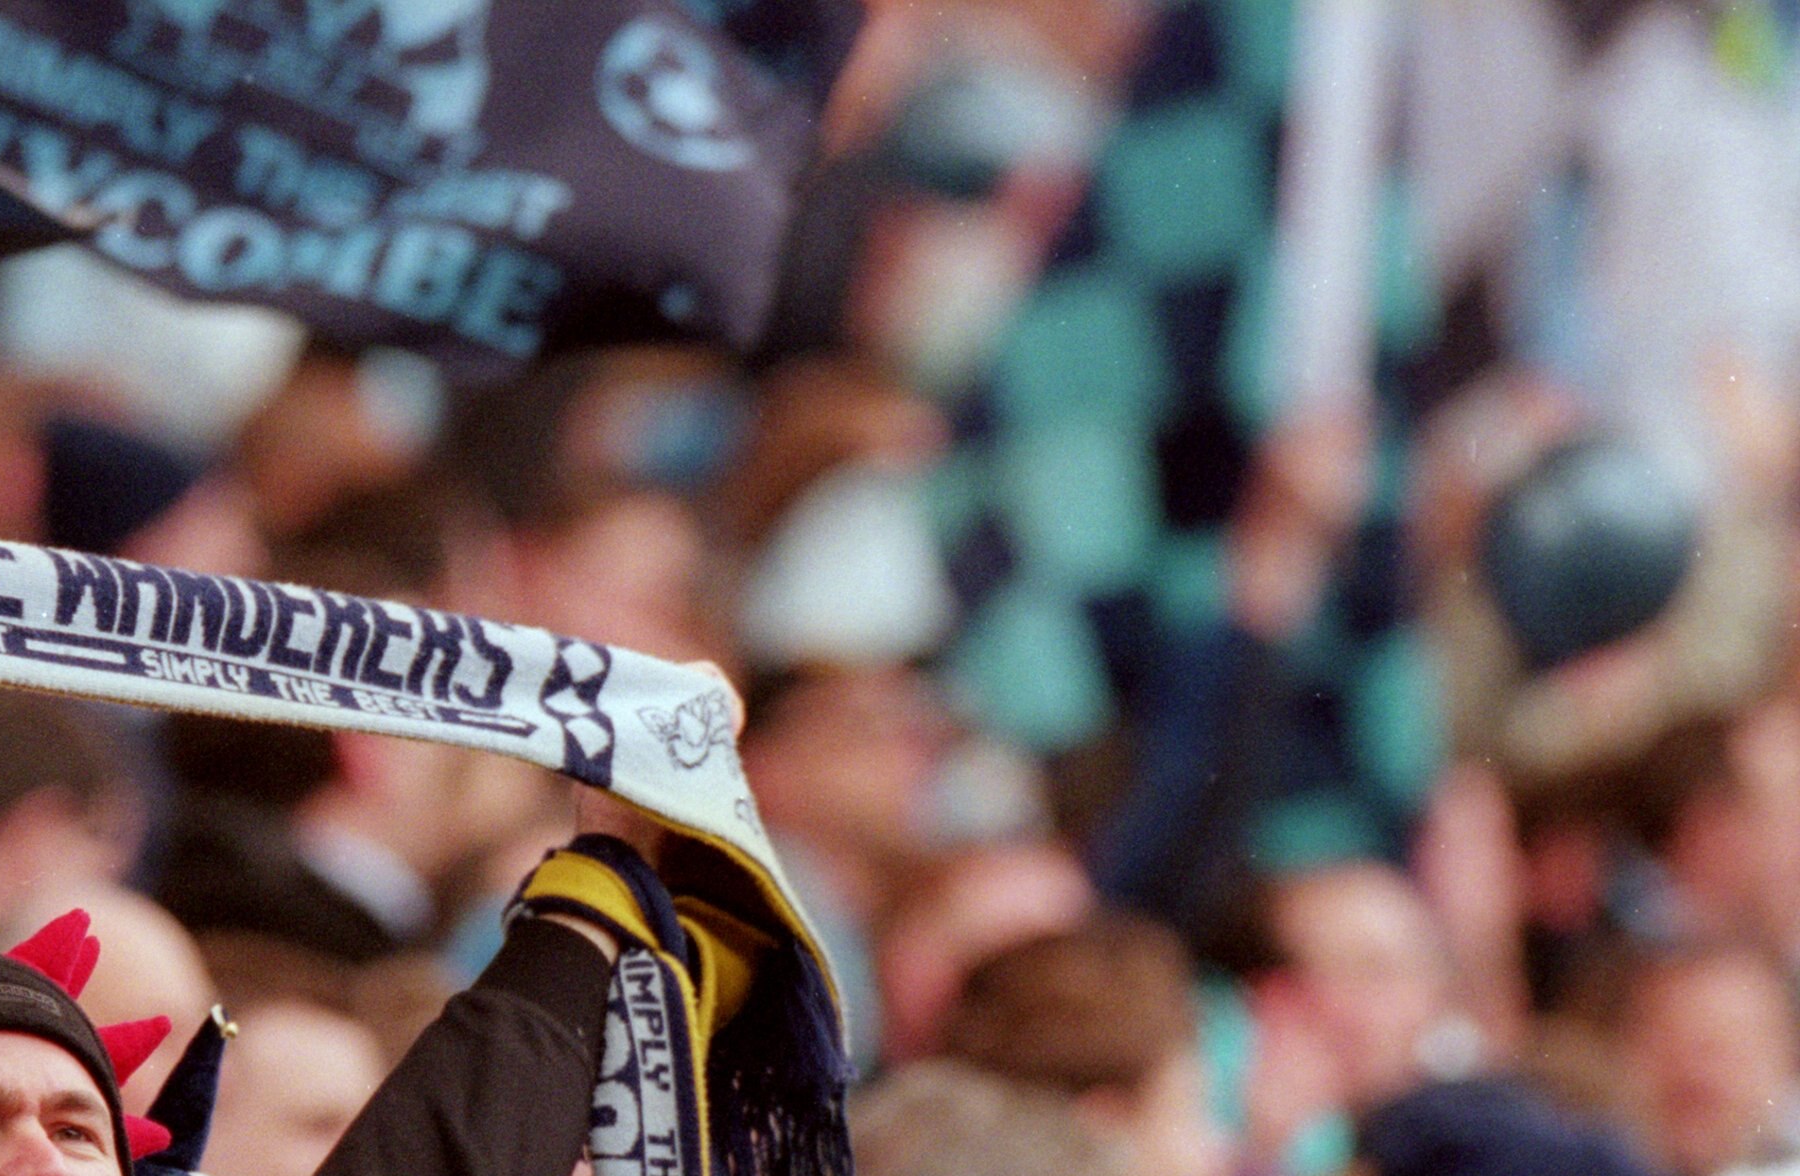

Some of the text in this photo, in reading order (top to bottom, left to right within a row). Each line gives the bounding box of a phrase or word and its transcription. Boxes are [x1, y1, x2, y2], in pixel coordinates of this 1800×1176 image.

[43, 546, 513, 710] WANDERERS
[140, 648, 444, 723] SIMPLY THE BEST
